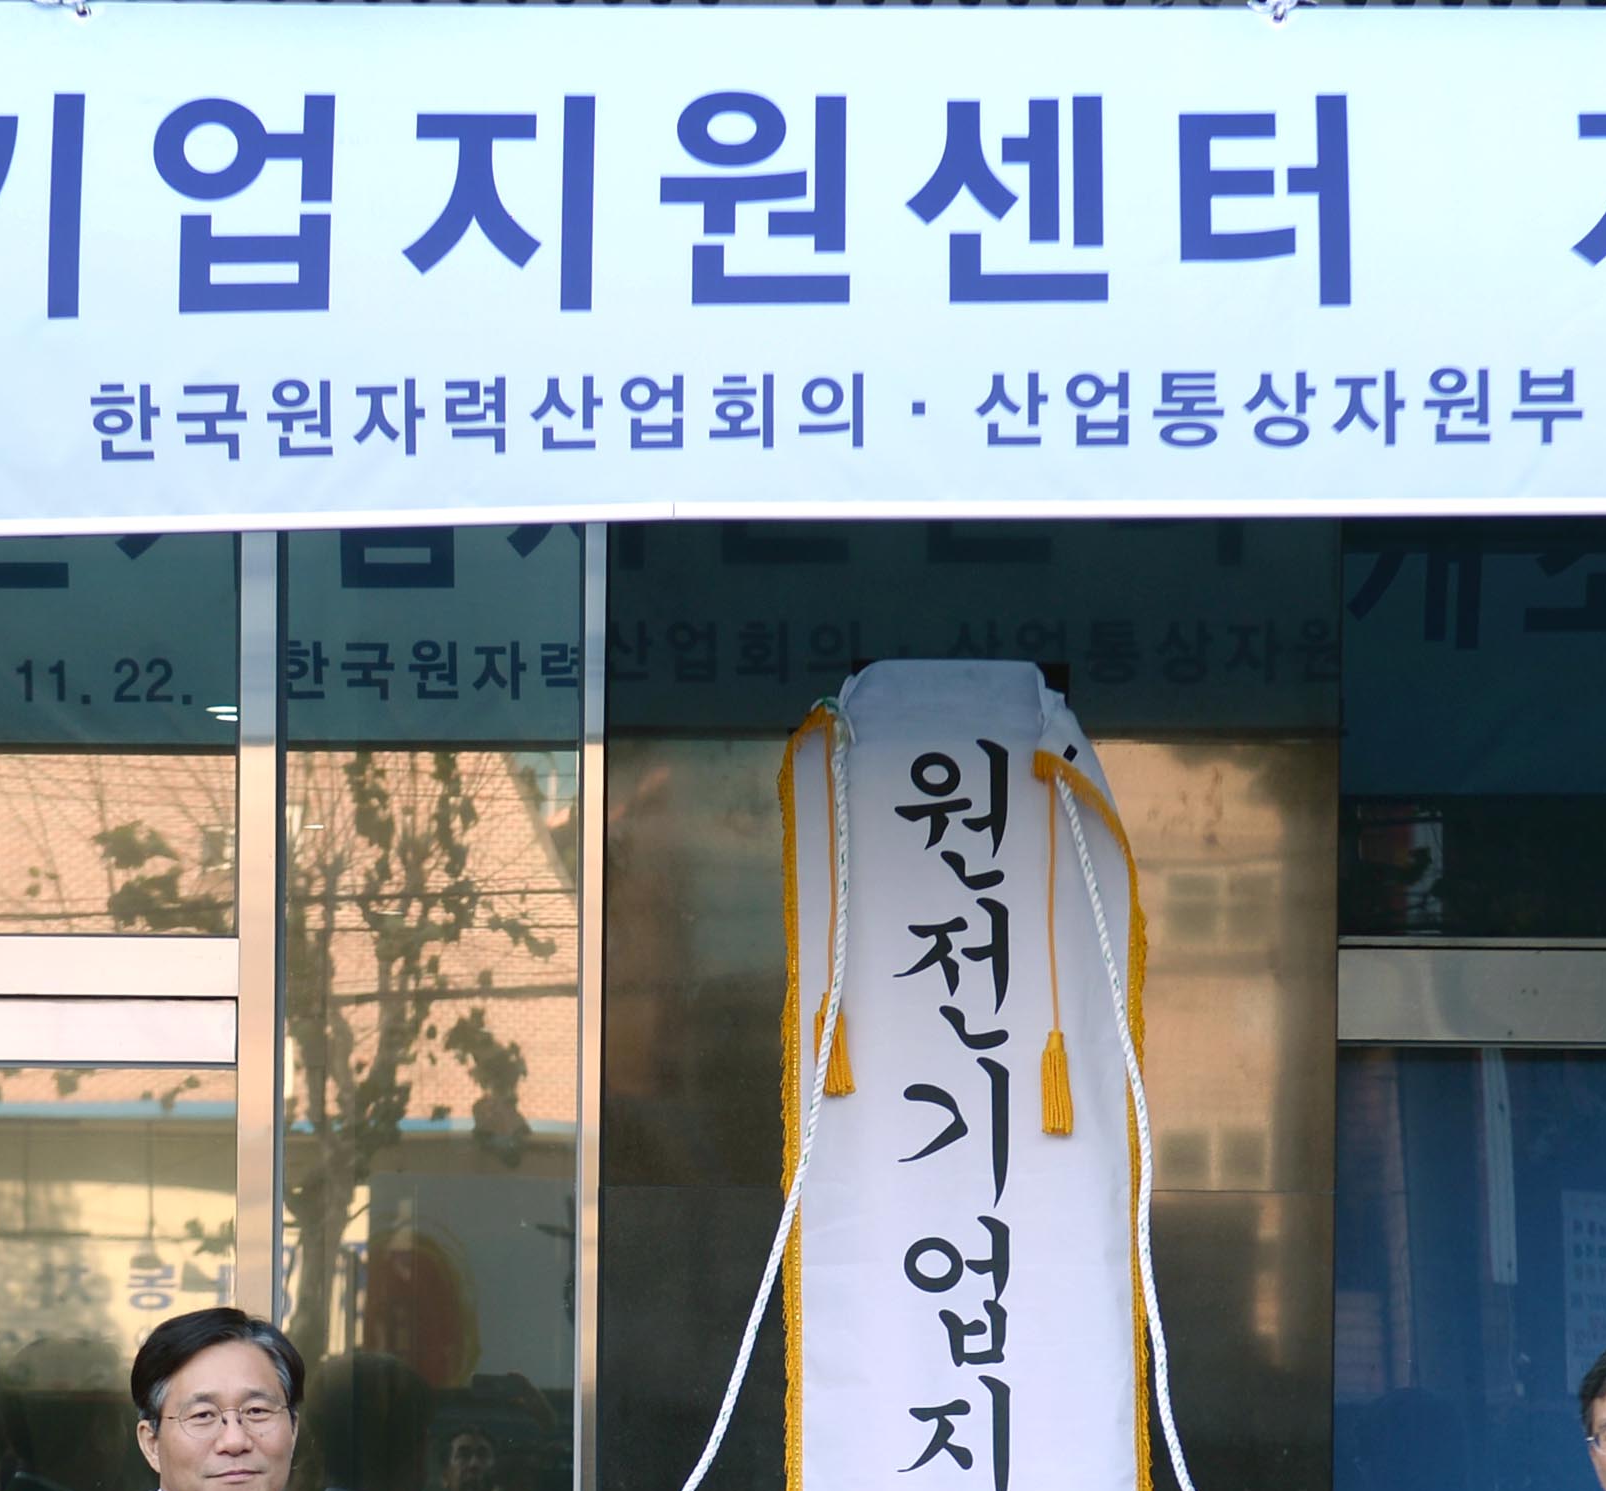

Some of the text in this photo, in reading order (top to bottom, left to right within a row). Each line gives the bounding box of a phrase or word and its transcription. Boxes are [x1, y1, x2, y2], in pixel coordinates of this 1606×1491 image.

[91, 373, 865, 463] 한국원자력산업회의
[976, 368, 1584, 449] 산업통상자원부
[15, 659, 91, 704] 11.
[113, 657, 192, 704] 22.
